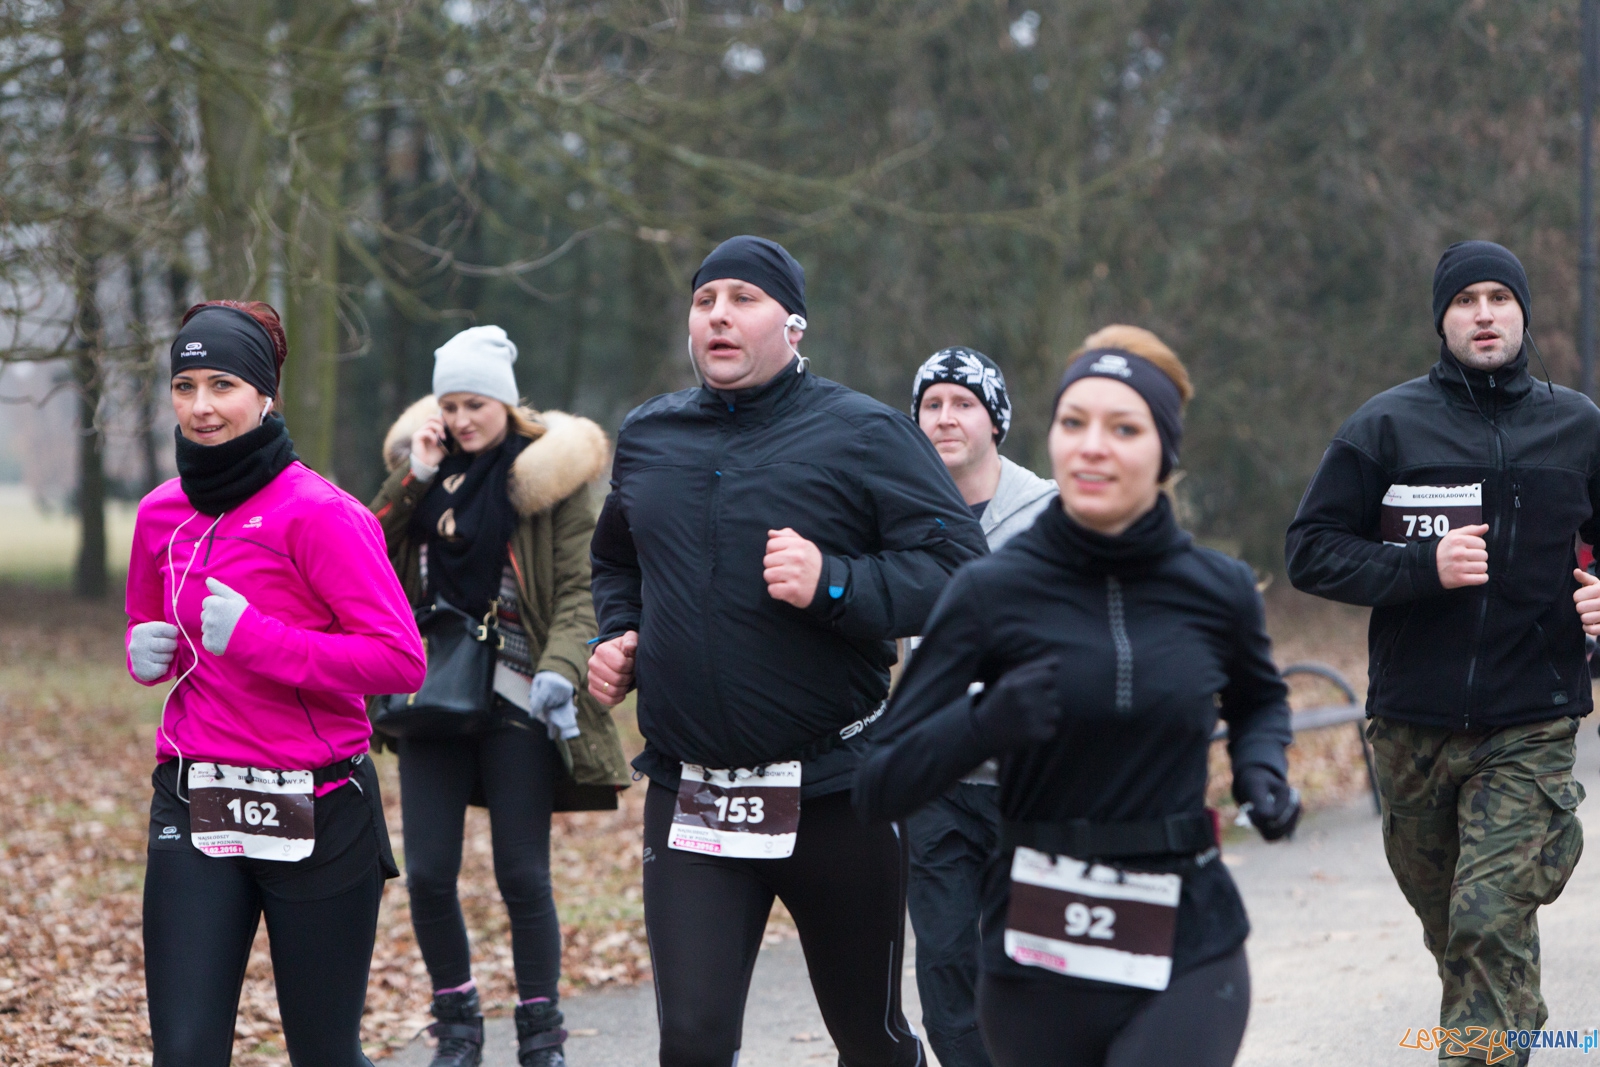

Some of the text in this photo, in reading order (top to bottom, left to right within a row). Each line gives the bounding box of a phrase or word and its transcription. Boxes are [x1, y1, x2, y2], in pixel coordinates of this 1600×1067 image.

[1403, 515, 1449, 537] 730
[227, 797, 280, 827] 162
[714, 796, 764, 824] 153
[1065, 902, 1116, 940] 92
